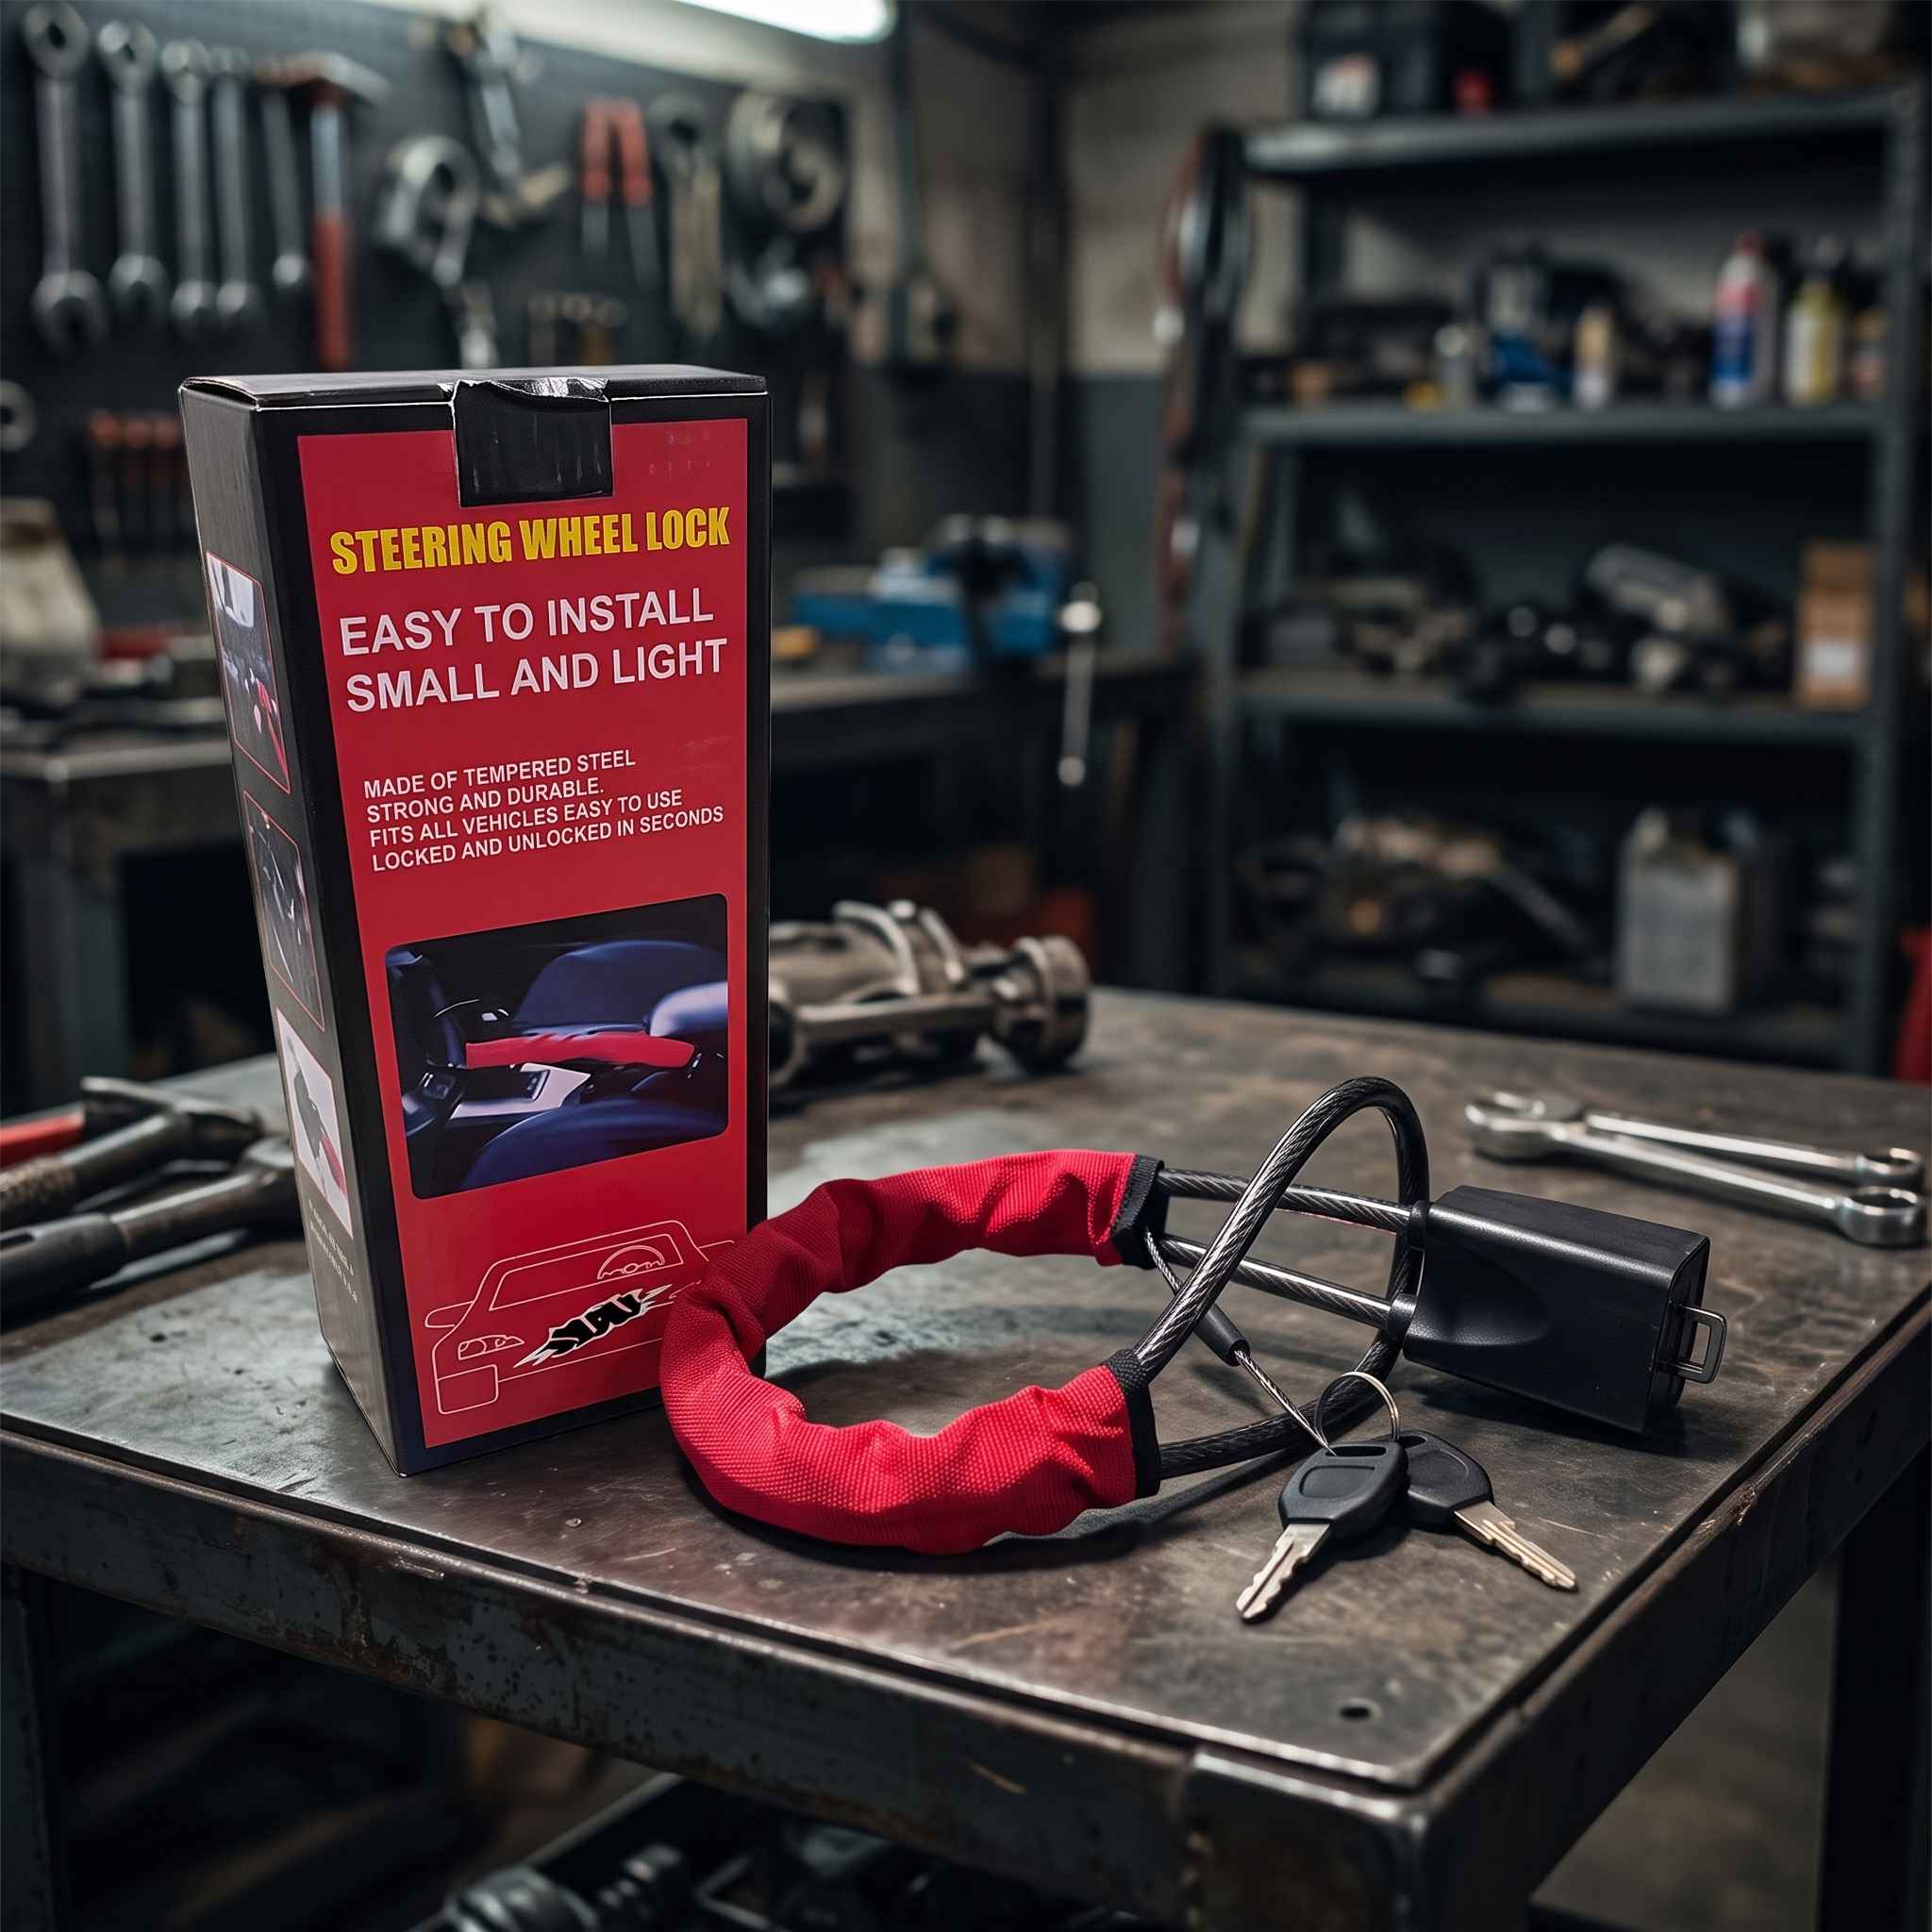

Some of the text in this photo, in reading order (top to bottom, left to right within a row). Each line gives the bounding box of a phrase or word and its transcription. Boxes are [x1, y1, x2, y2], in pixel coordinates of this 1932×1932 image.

[330, 506, 730, 575] STEERING WHEEL LOCK
[340, 587, 714, 657] EASY TO INSTALL
[346, 638, 728, 712] SMALL AND LIGHT
[363, 749, 637, 799] MADE OF TEMPERED STEEL
[366, 776, 604, 824] STRONG AND DURABLE.
[369, 789, 683, 848] FITS ALL VEHICLES EASY TO USE
[372, 806, 724, 872] LOCKED AND UNLOCKED IN SECONDS
